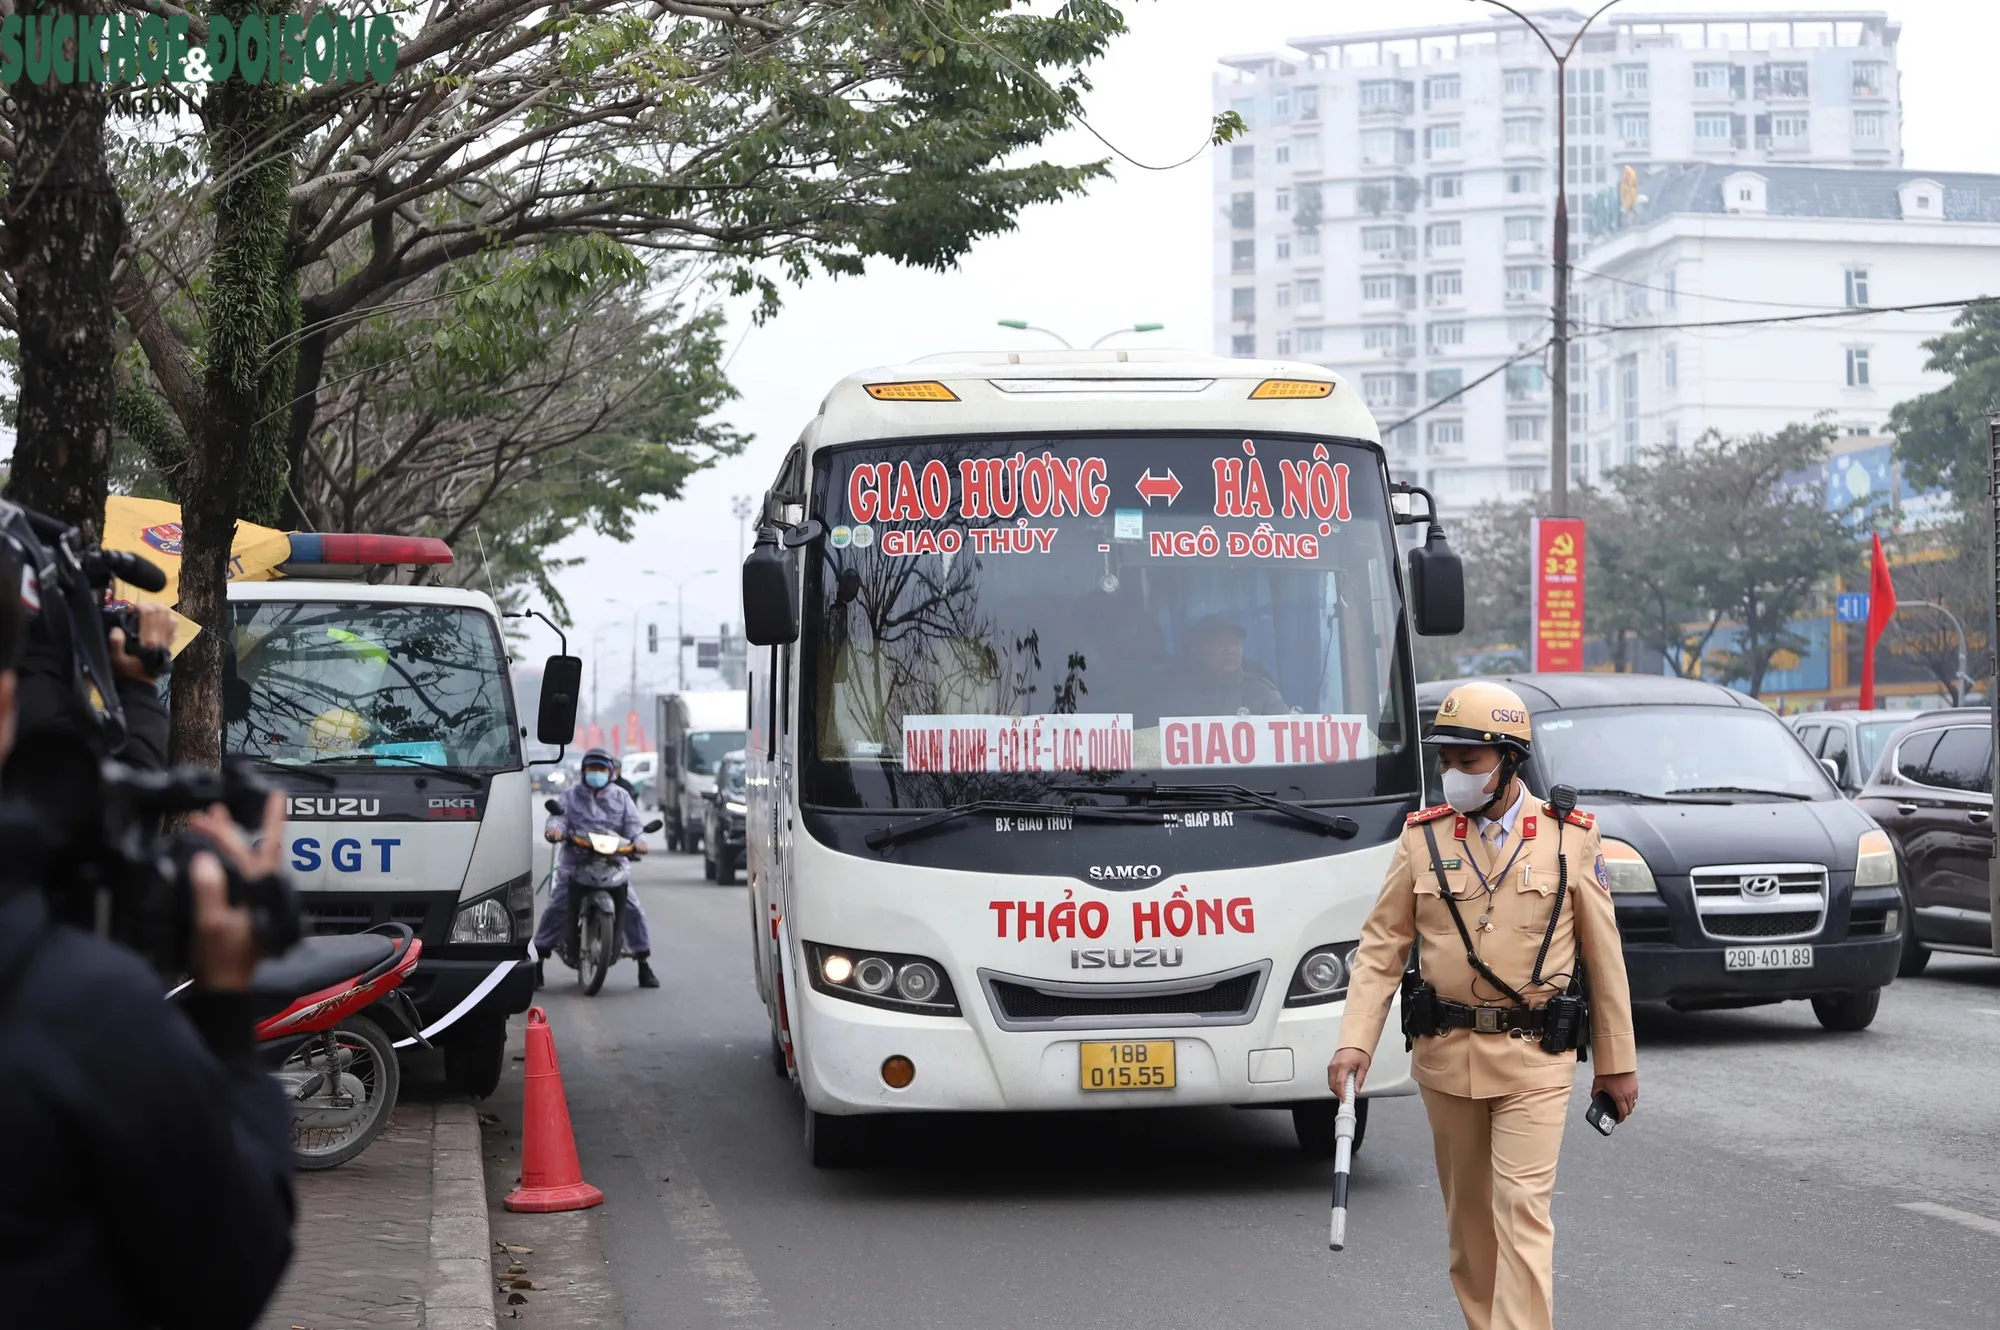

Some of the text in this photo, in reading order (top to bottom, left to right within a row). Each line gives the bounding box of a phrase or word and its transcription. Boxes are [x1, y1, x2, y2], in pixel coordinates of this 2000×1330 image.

[849, 439, 1352, 537] GIAO HƯƠNG HÀ NỘI
[882, 529, 961, 557] GIAO
[969, 517, 1058, 554] THỦY
[1151, 525, 1220, 557] NGÔ
[1226, 522, 1319, 559] ĐỒNG
[1491, 708, 1526, 724] CSGT
[907, 729, 944, 773] NAM
[1165, 714, 1362, 766] GIAO THỦY
[286, 797, 380, 816] ISUZU
[428, 798, 476, 808] QKR
[252, 838, 401, 873] SGT
[1089, 865, 1162, 880] SAMCO
[989, 884, 1255, 943] THẢO HỒNG
[1071, 946, 1183, 969] ISUZU
[1110, 1044, 1148, 1064] 18B
[1091, 1066, 1165, 1087] 015.55
